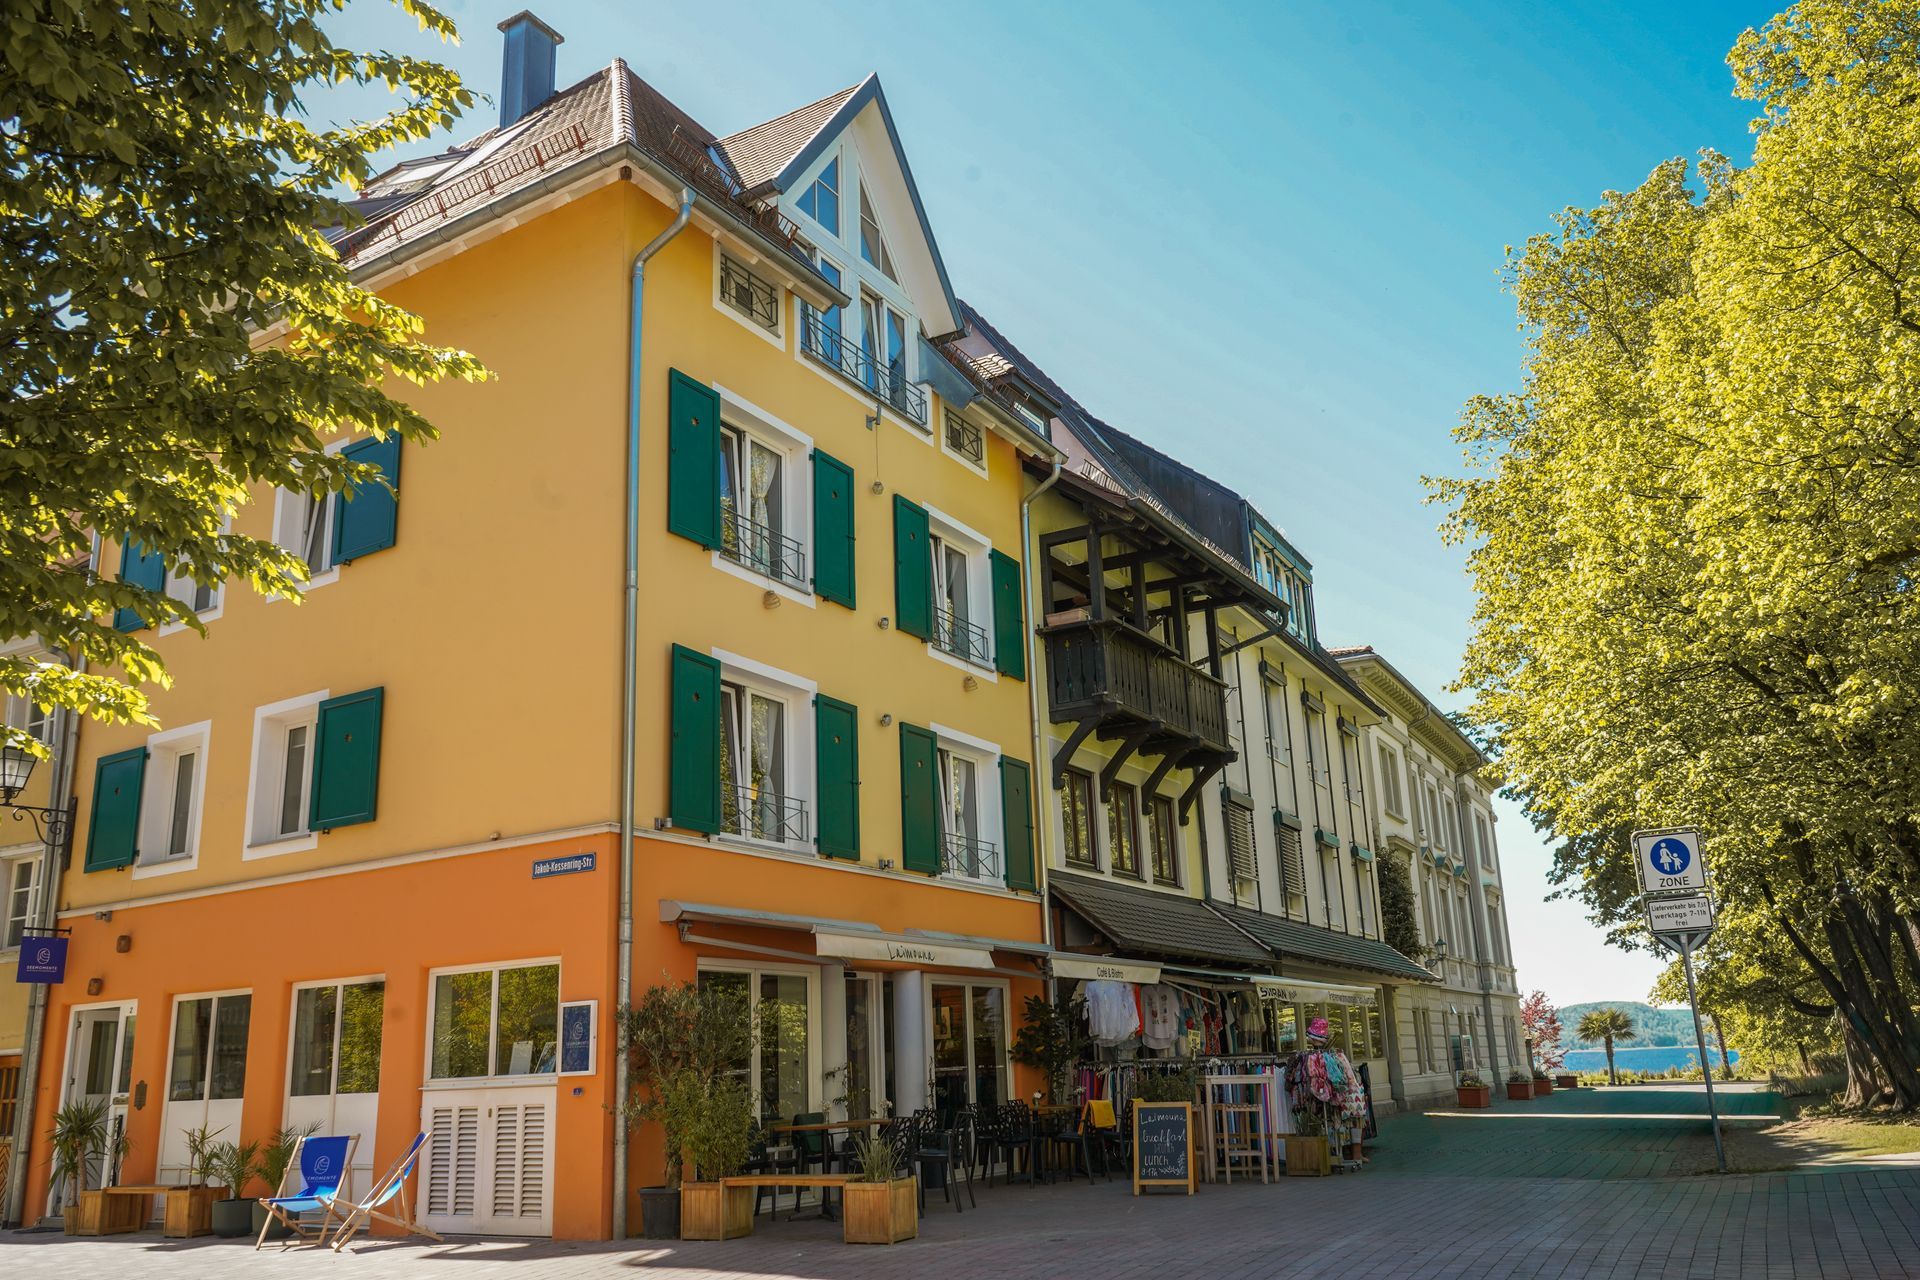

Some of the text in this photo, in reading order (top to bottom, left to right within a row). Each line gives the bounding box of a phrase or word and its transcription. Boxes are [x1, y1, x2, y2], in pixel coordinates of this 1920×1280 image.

[1659, 876, 1690, 888] ZONE
[1651, 902, 1687, 912] Lieferverkehr
[1654, 909, 1707, 920] werktags 7-11h
[1675, 919, 1689, 927] frei
